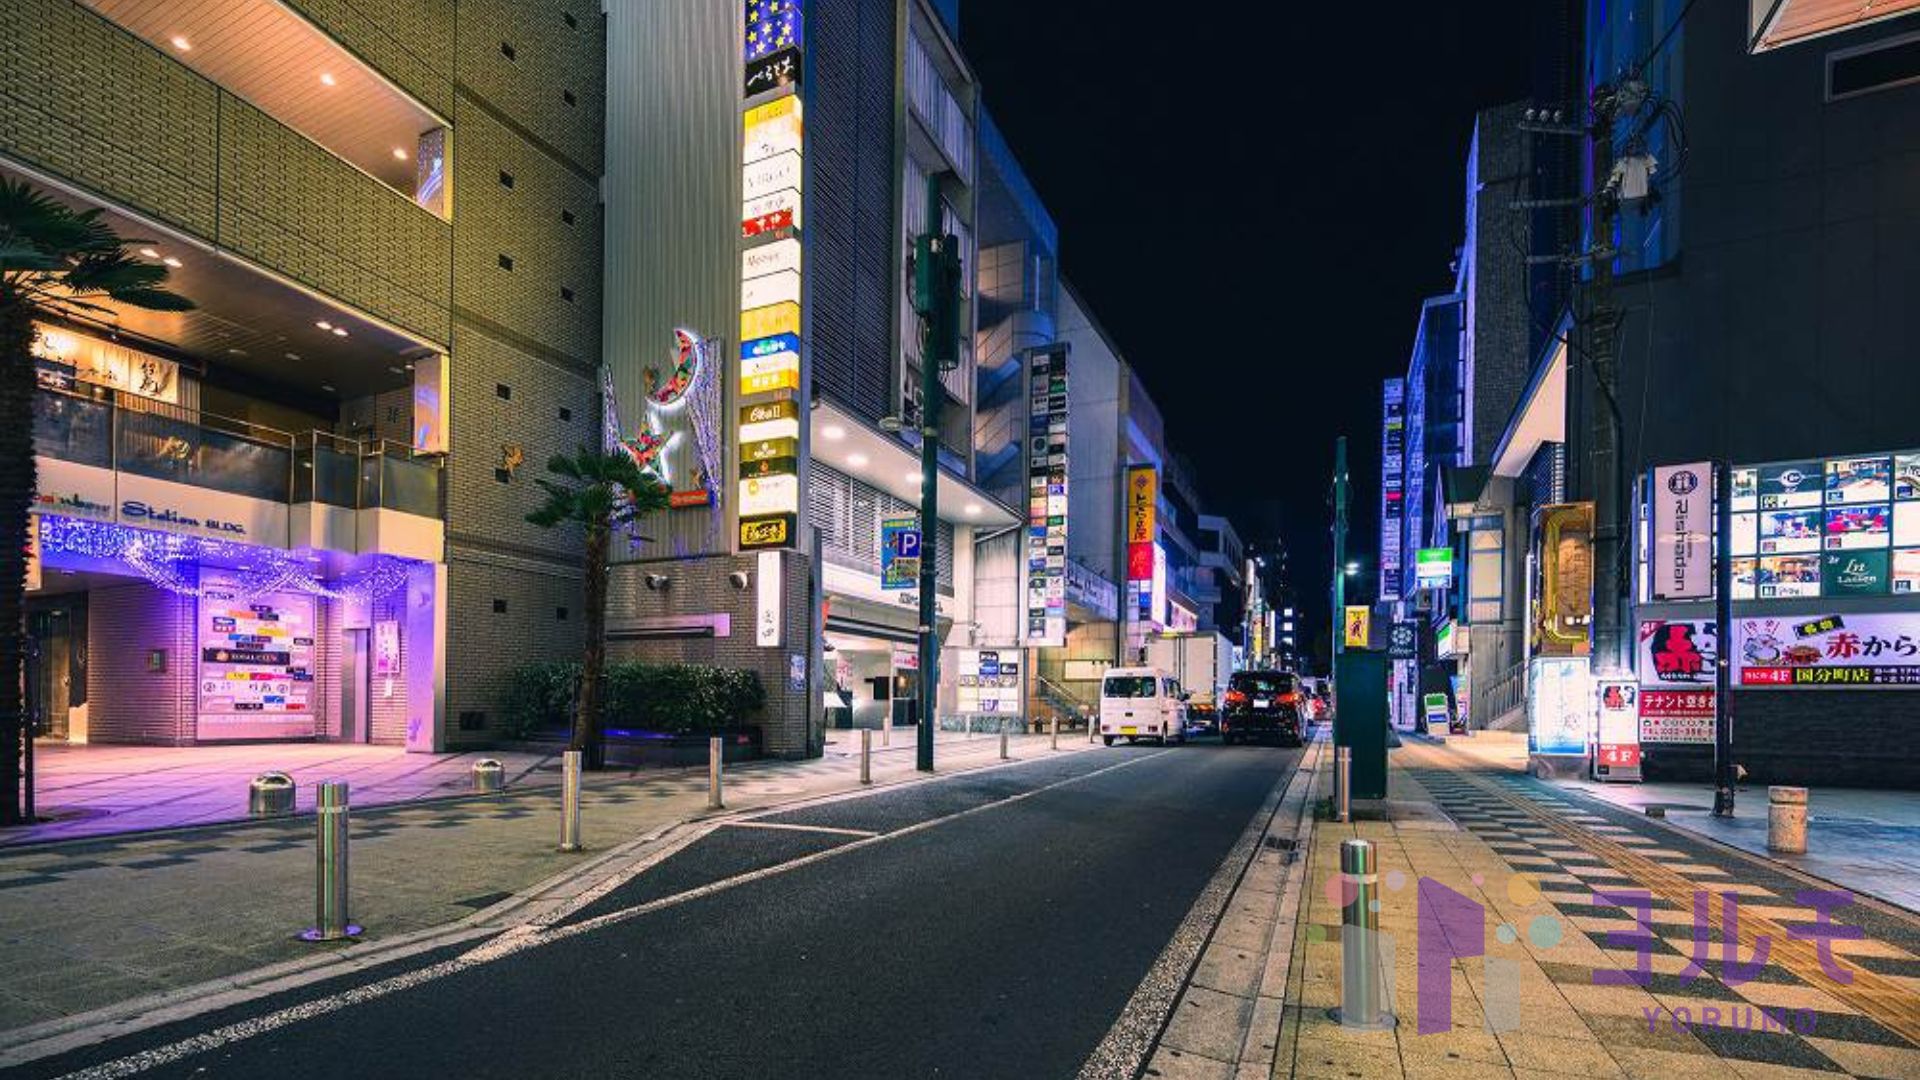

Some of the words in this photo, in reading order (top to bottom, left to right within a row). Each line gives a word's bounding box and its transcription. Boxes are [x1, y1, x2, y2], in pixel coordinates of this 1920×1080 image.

[903, 533, 917, 554] P
[1769, 669, 1791, 682] 4F
[1796, 667, 1870, 682] 国分町店
